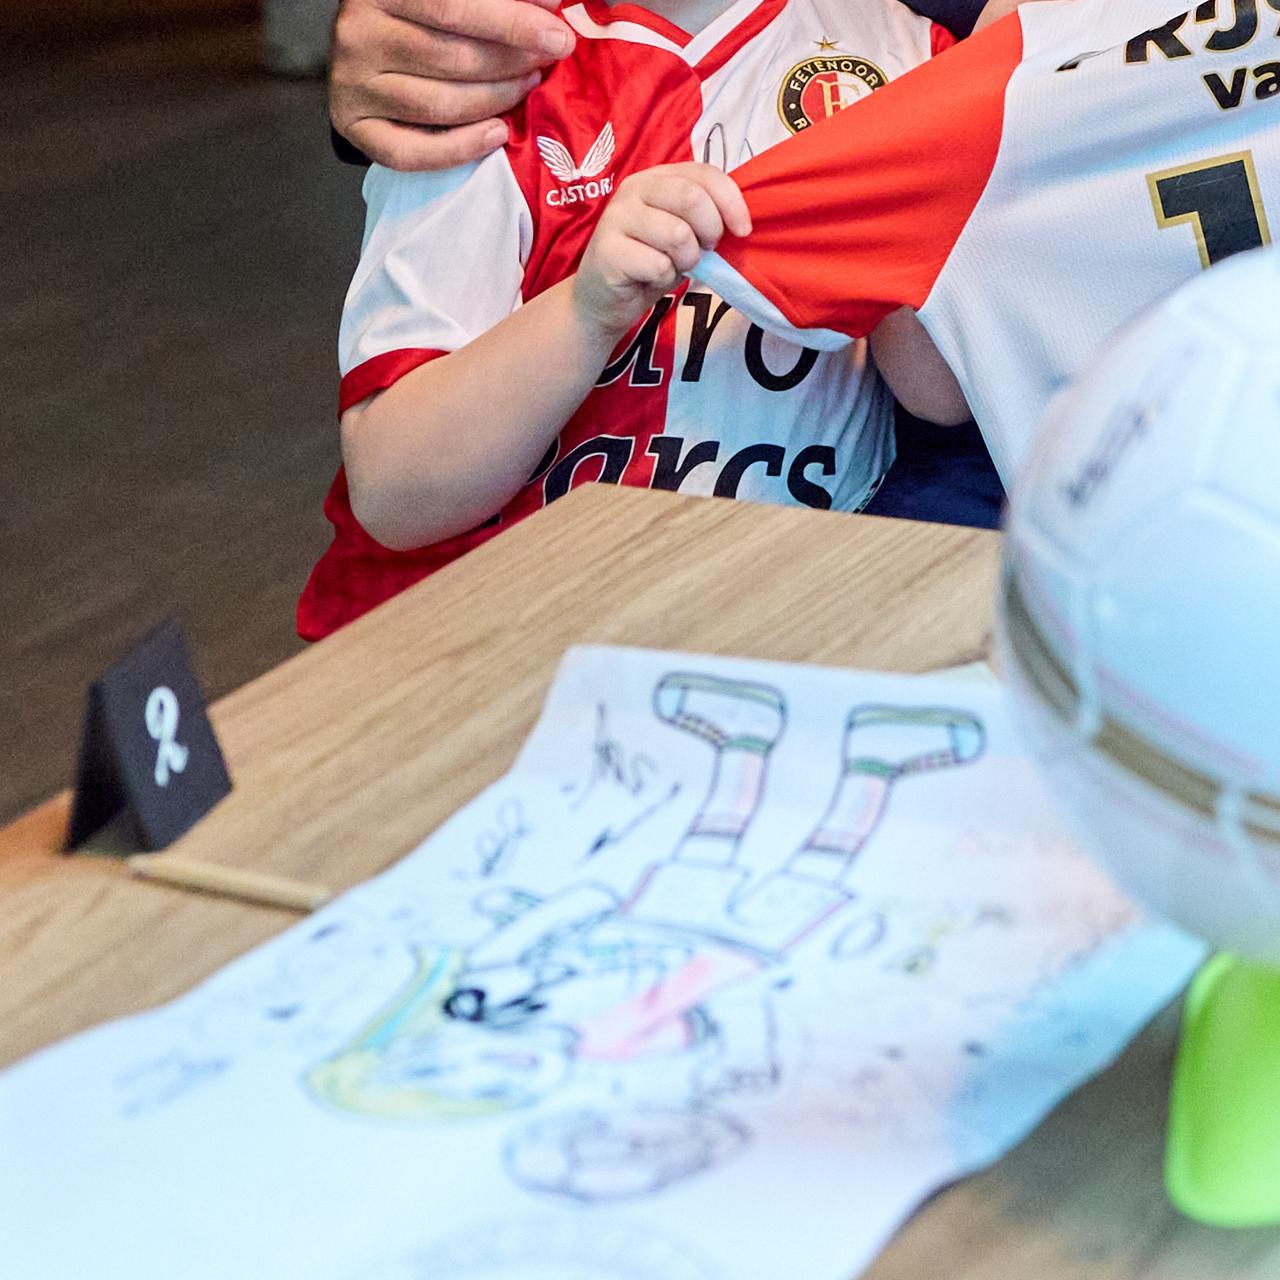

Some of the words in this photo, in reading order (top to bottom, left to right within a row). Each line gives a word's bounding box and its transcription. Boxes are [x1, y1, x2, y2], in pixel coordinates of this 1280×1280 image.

[789, 60, 879, 92] FEYENOOR
[546, 172, 615, 207] CASTOR
[593, 291, 820, 392] uro
[526, 433, 837, 511] arcs
